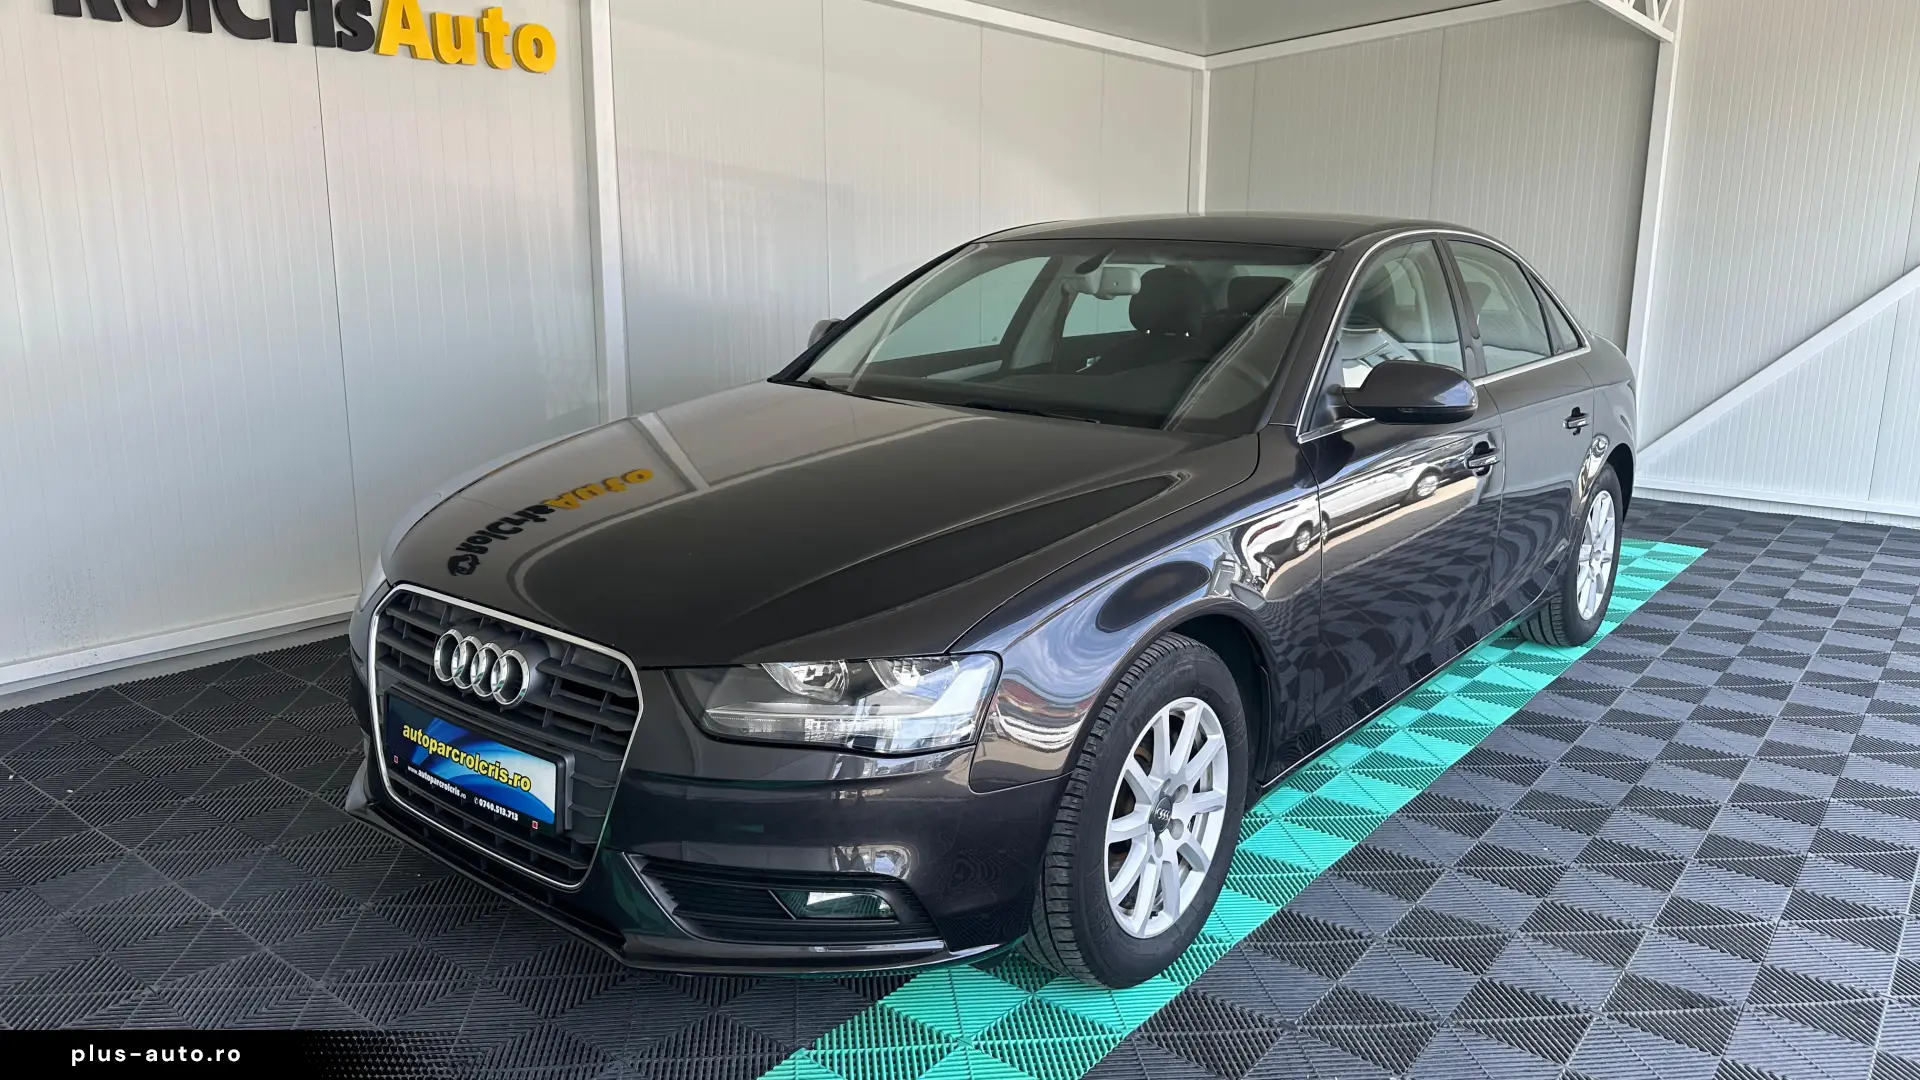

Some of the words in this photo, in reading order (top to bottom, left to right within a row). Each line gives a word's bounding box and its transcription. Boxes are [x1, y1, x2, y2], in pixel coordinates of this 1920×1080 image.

[402, 723, 532, 792] autoparcrolcris.ro
[407, 765, 467, 800] www.autoparcrolcris.ro
[478, 798, 519, 822] 0740.513.713
